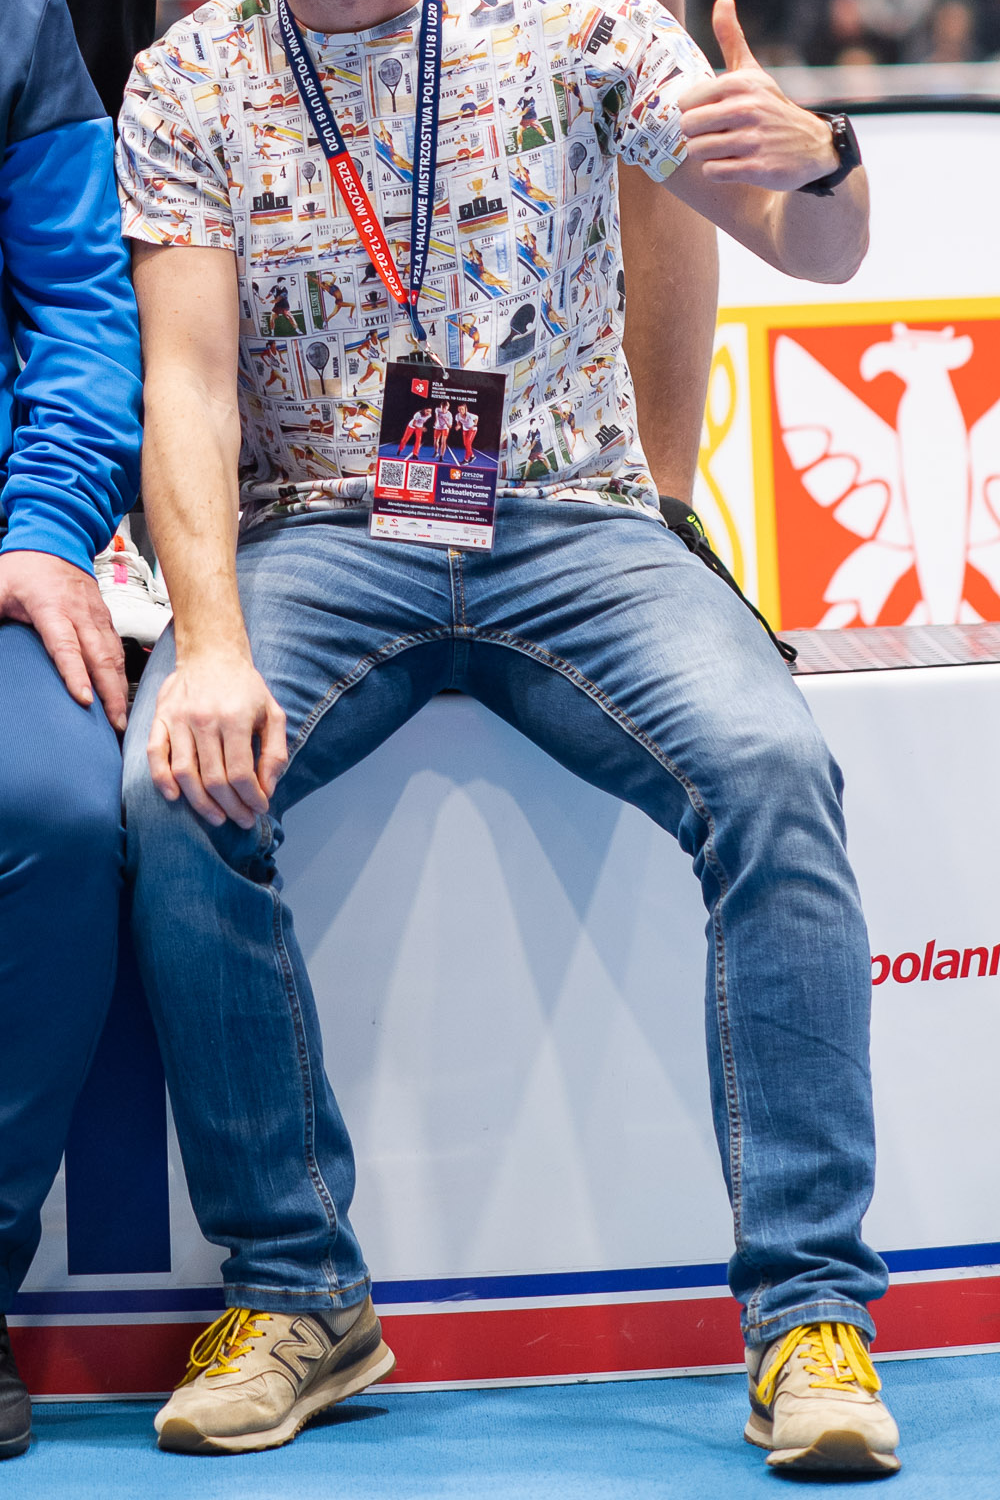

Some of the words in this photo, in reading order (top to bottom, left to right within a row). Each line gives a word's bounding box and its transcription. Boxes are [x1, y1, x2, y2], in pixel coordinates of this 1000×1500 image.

[428, 3, 438, 26] U20
[425, 34, 437, 58] U18
[550, 58, 568, 70] ROME
[423, 59, 436, 103] POLSKI
[536, 84, 543, 94] 5
[295, 55, 316, 98] POLSKI
[310, 98, 327, 122] U18
[322, 126, 339, 152] U20
[418, 105, 433, 195] MISTRZOSTWA
[279, 165, 287, 179] 4
[382, 172, 392, 182] 40
[491, 167, 499, 180] 4
[517, 208, 527, 217] 40
[336, 161, 368, 217] RZESZÓW
[361, 218, 403, 297] 10-12.02.2023
[415, 197, 429, 251] HALOWE
[413, 254, 424, 285] PZLA
[437, 262, 456, 272] ATHENS
[290, 277, 297, 286] 5
[521, 275, 531, 286] 40
[469, 292, 479, 302] 40
[499, 292, 531, 307] NIPPON
[499, 309, 509, 317] 40
[364, 315, 387, 327] XXVII
[429, 322, 436, 336] 4
[509, 409, 523, 423] ROME
[539, 414, 545, 425] 5
